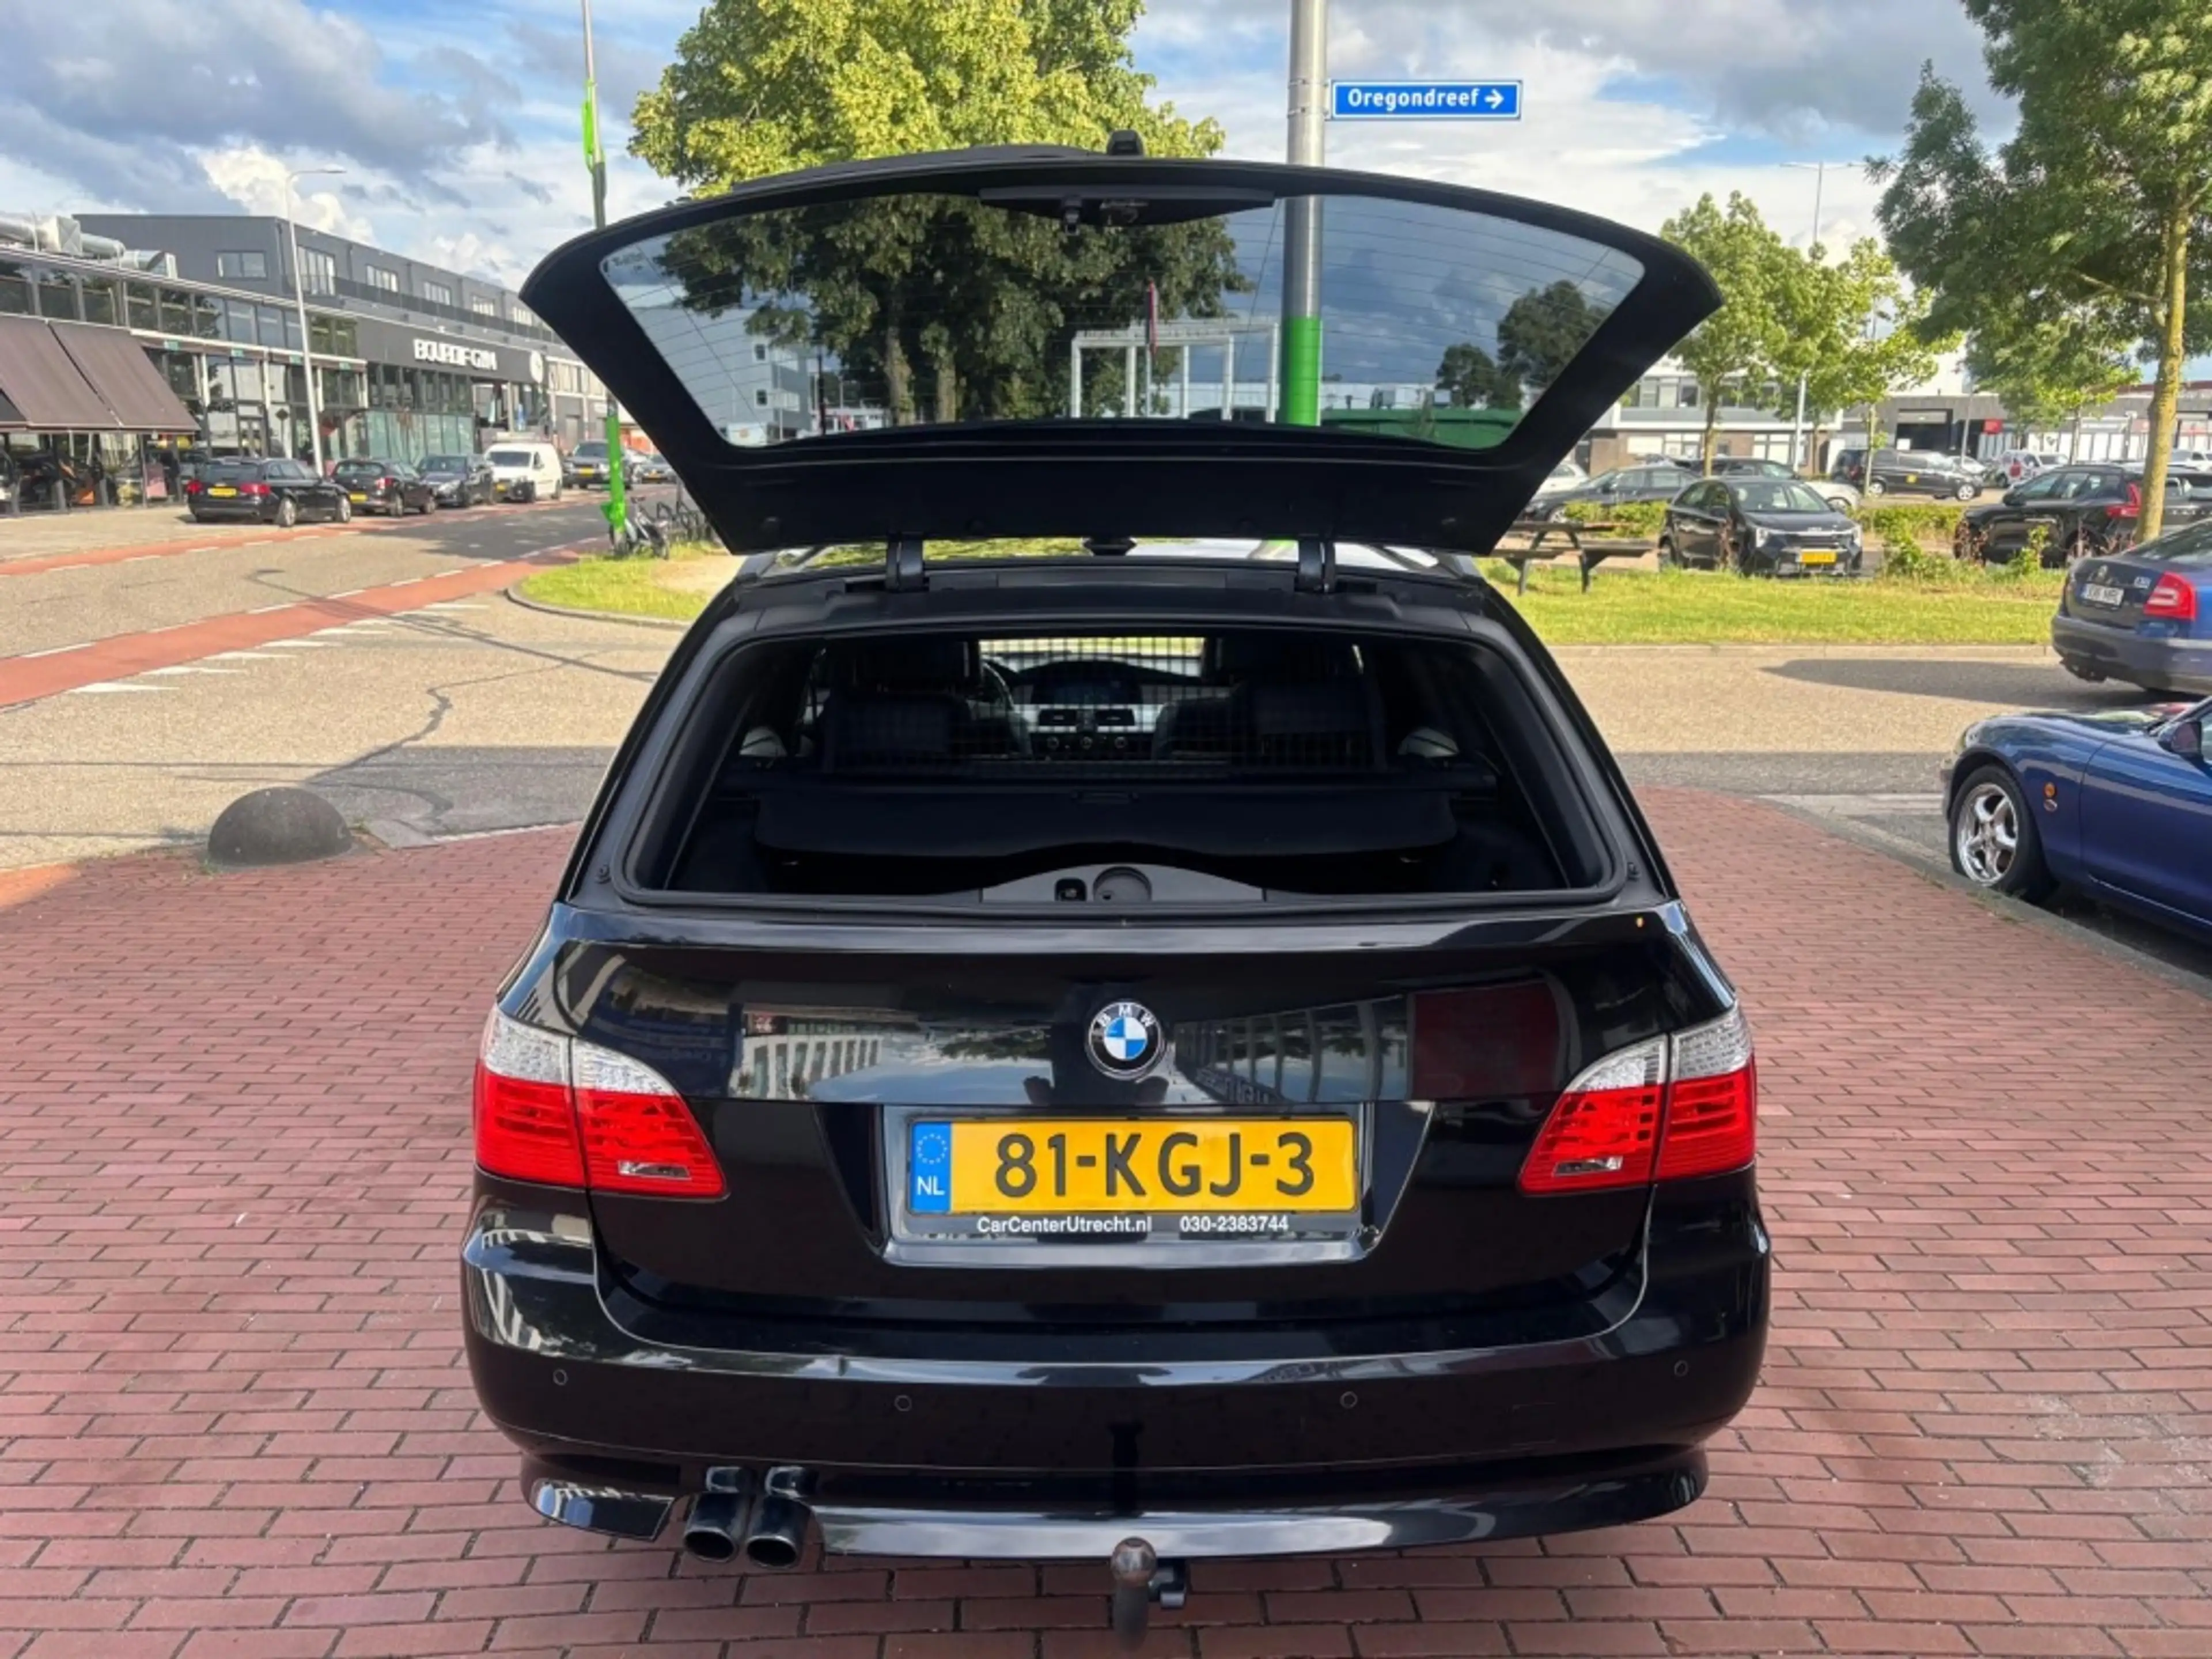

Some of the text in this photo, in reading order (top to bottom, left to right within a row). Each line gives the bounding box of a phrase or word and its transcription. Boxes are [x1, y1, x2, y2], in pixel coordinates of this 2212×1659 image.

[1348, 88, 1479, 111] Oregondreef
[996, 1132, 1314, 1198] 81-KGJ-3
[917, 1177, 945, 1196] NL
[976, 1214, 1289, 1233] CarCenterUtrecht.nl 030-2383744
